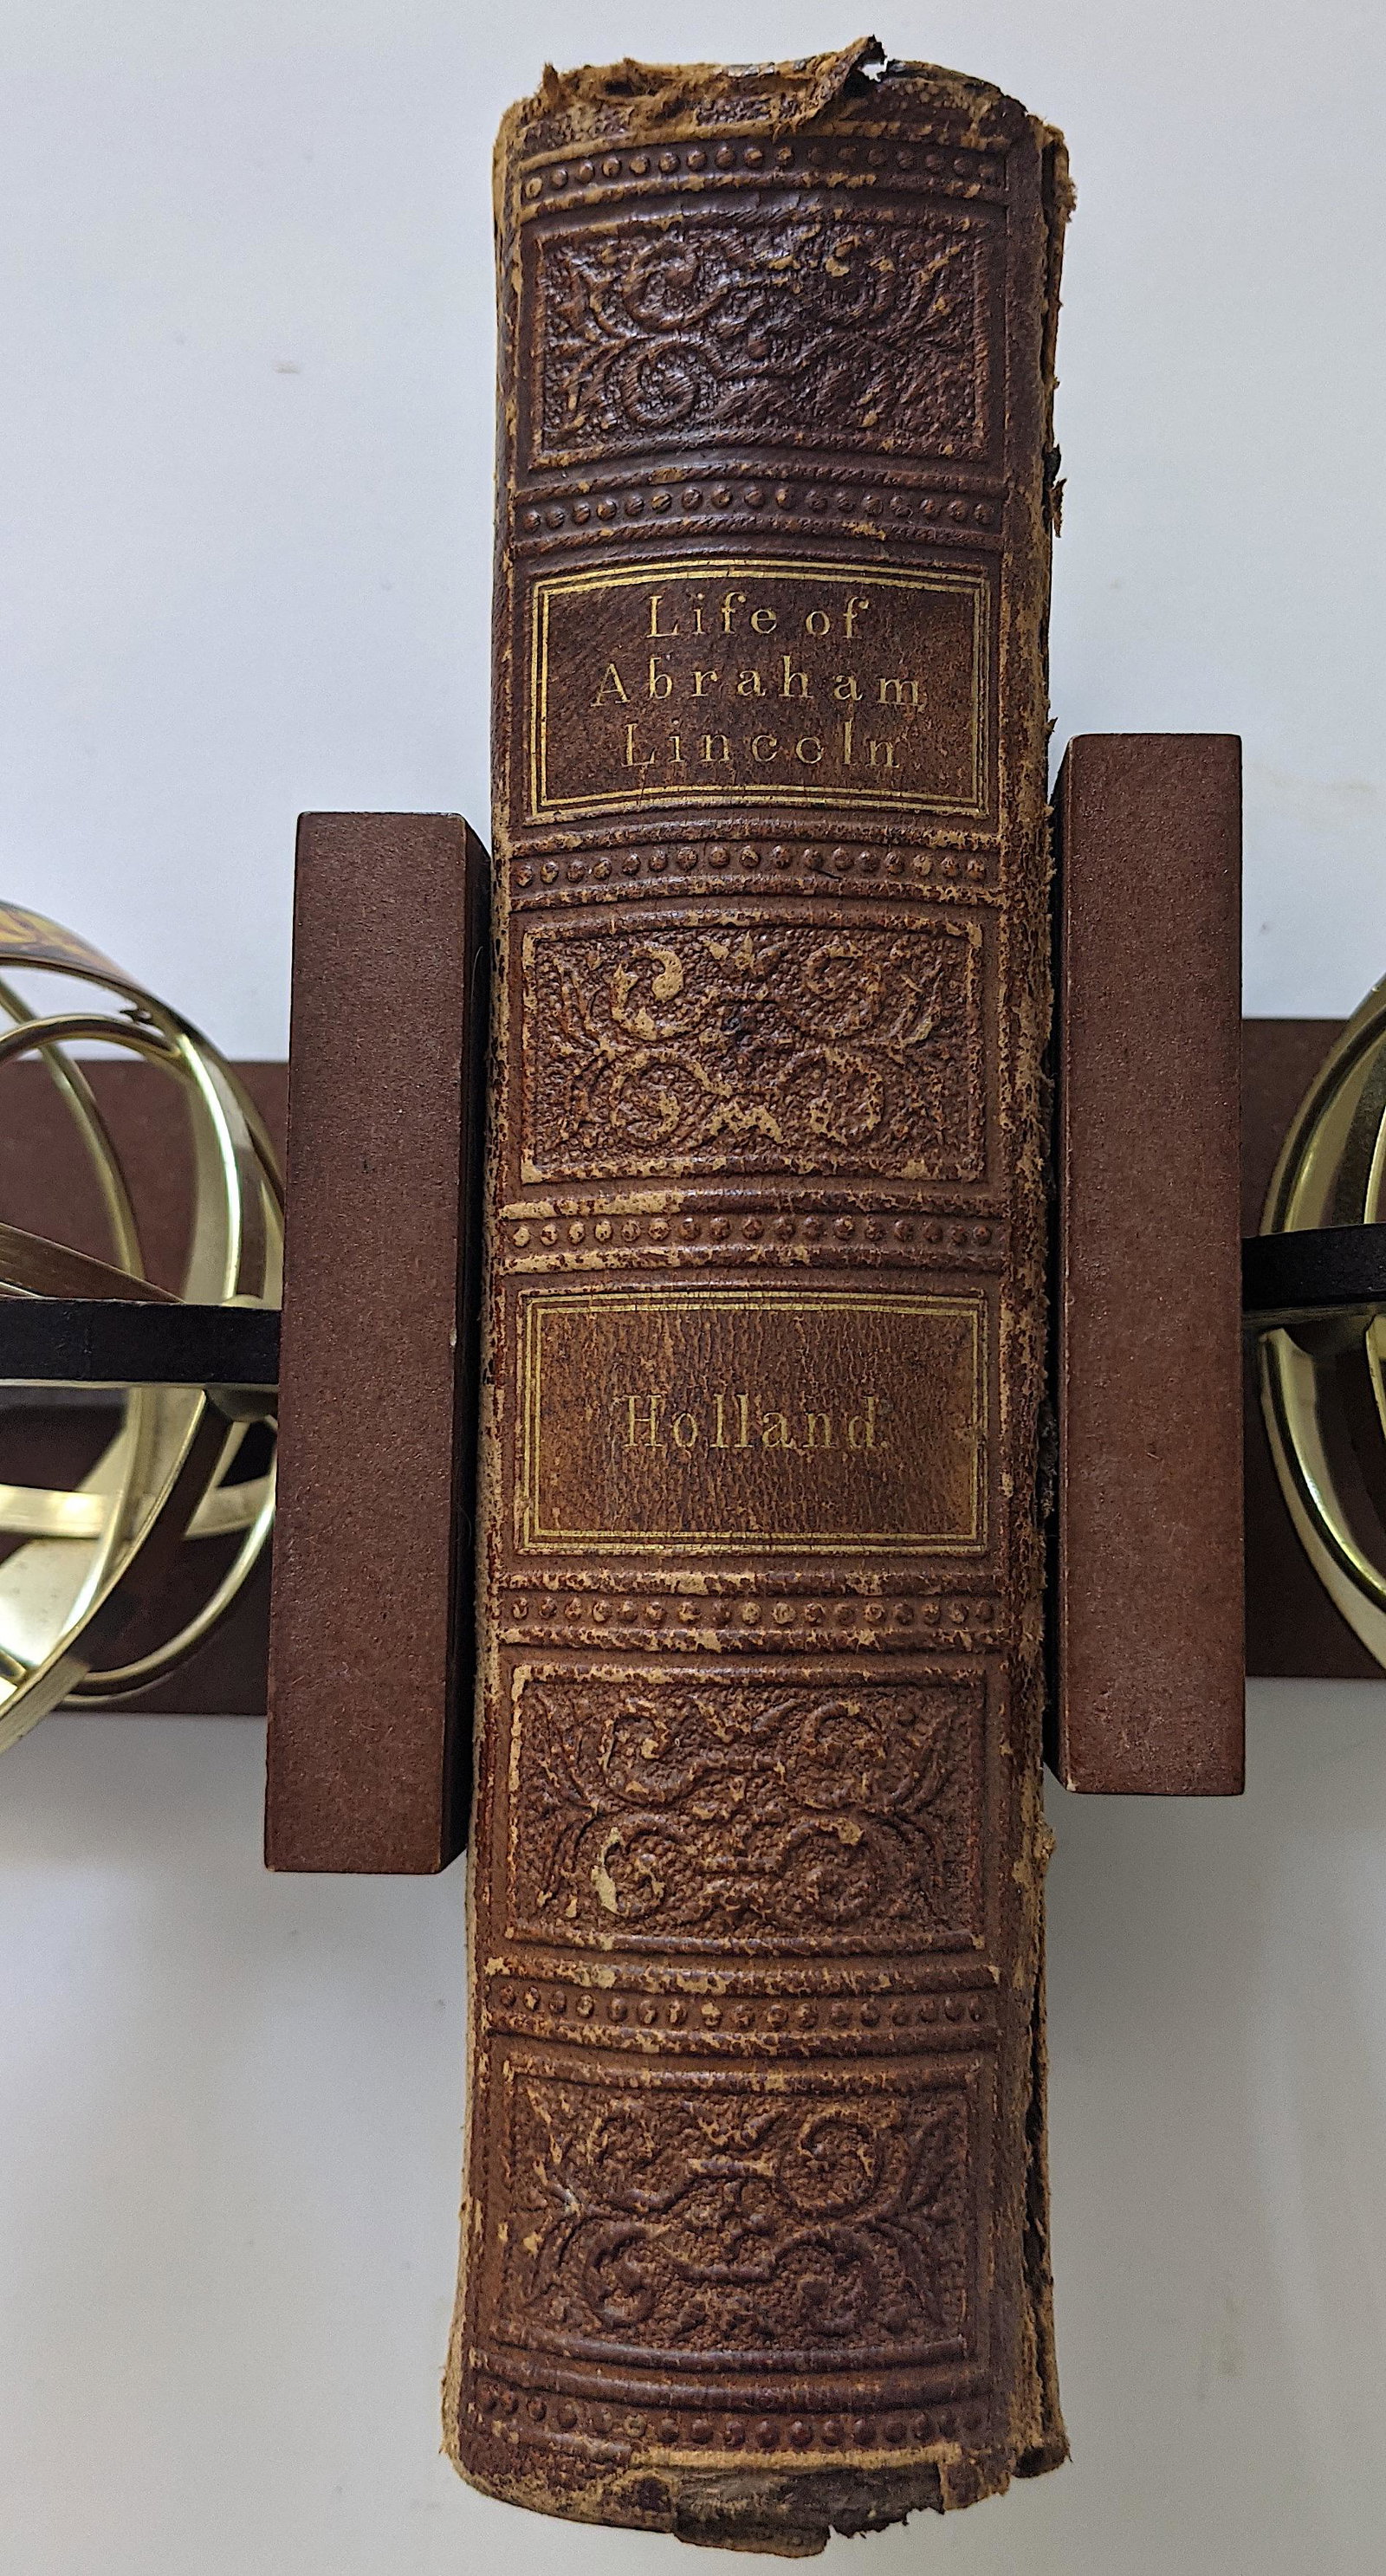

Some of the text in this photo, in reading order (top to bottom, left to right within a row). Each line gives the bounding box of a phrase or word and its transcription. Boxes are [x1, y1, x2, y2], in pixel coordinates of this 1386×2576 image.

[646, 592, 871, 638] Life of
[621, 718, 899, 769] Lincoln
